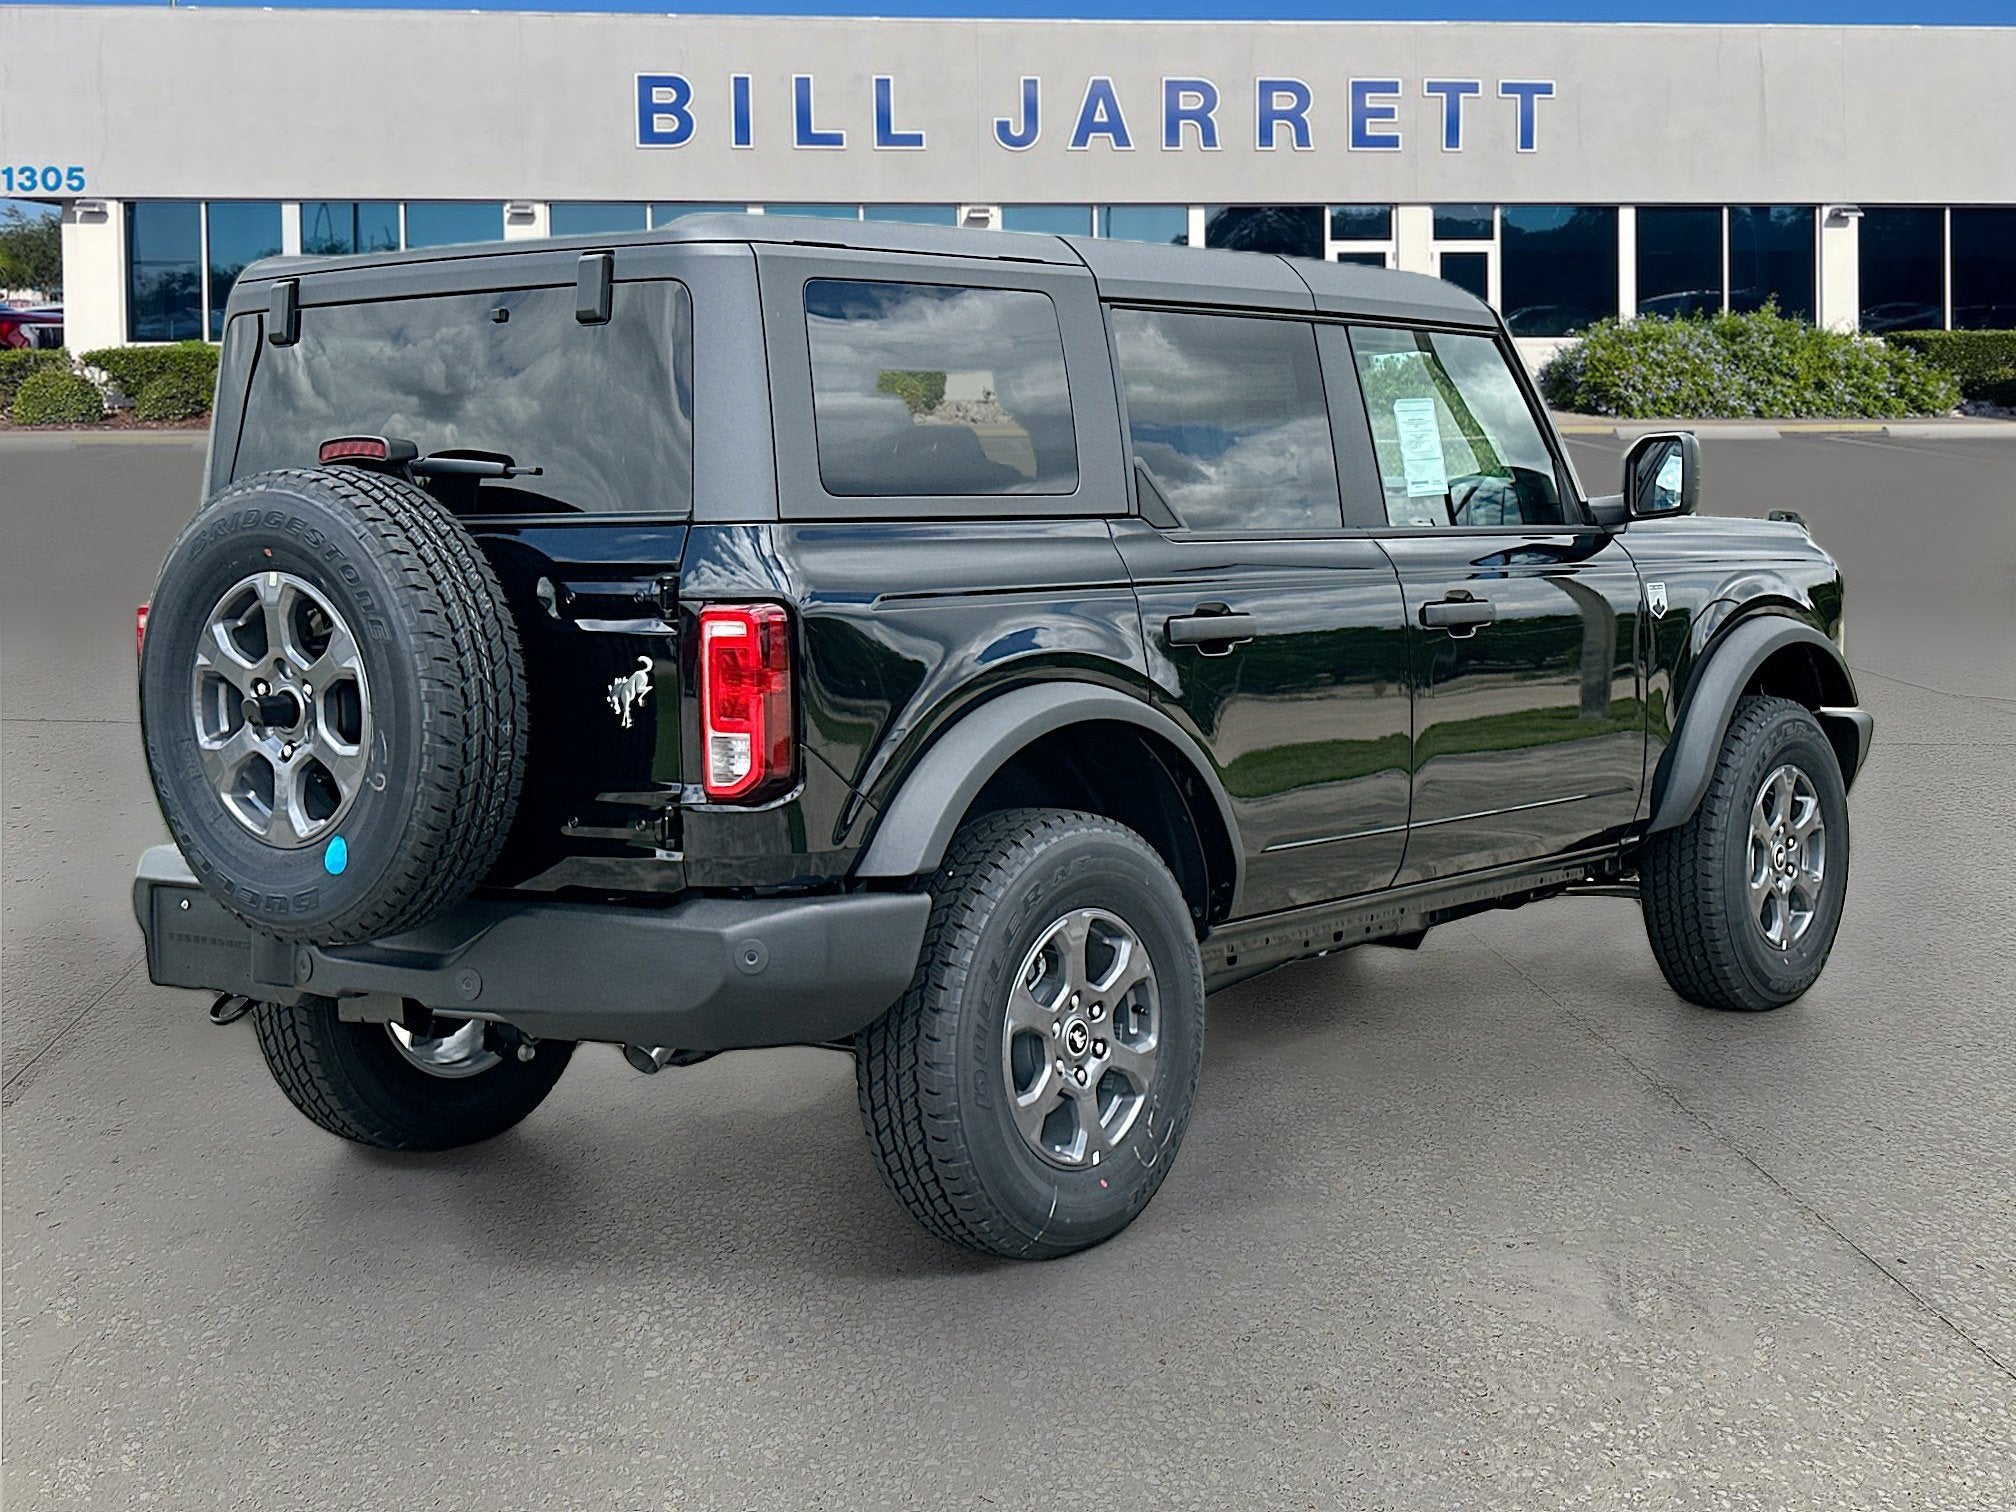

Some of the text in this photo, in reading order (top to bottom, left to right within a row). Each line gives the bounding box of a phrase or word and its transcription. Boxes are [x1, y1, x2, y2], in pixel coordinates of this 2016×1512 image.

[634, 73, 1557, 154] BILL JARRETT
[1, 166, 86, 192] 1305
[190, 508, 392, 643] BRIDGESTONE
